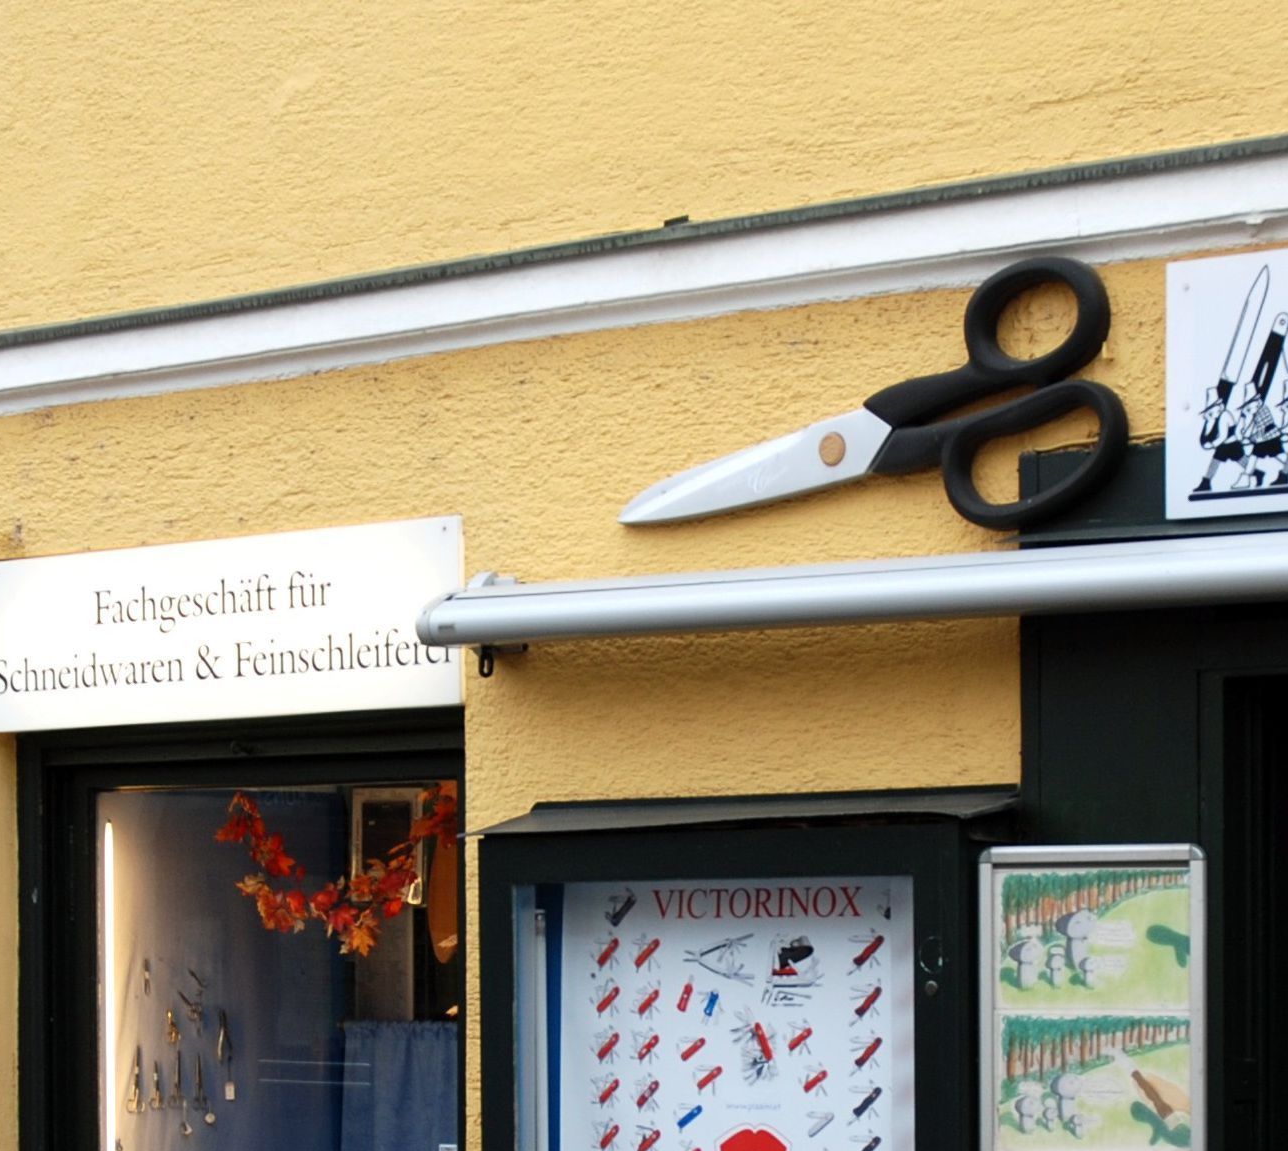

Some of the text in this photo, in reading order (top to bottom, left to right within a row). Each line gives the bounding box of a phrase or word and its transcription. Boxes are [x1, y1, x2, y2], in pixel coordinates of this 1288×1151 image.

[95, 571, 331, 633] Fachgeschäft für
[196, 646, 220, 680] &
[653, 886, 863, 919] VICTORINOX
